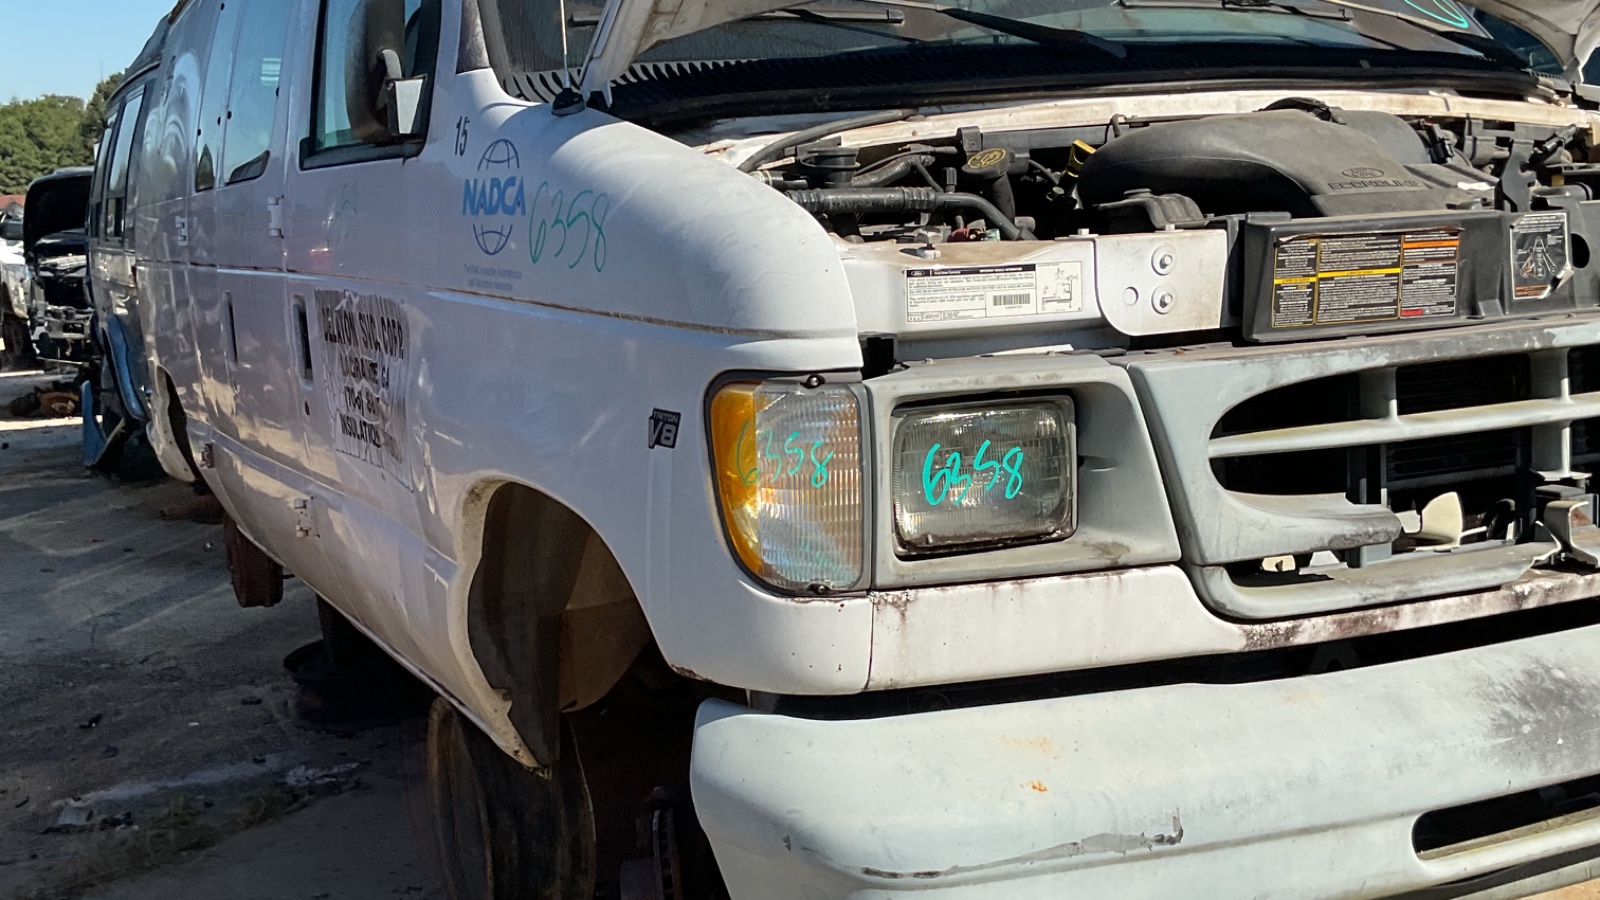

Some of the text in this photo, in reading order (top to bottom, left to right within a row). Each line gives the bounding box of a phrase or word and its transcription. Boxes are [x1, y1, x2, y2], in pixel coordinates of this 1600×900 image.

[455, 115, 470, 157] 15
[462, 175, 527, 217] NADCA
[529, 180, 612, 273] 6358
[649, 418, 677, 448] V8
[653, 411, 680, 425] TRITON
[735, 419, 834, 489] 6358
[922, 439, 1024, 506] 6358
